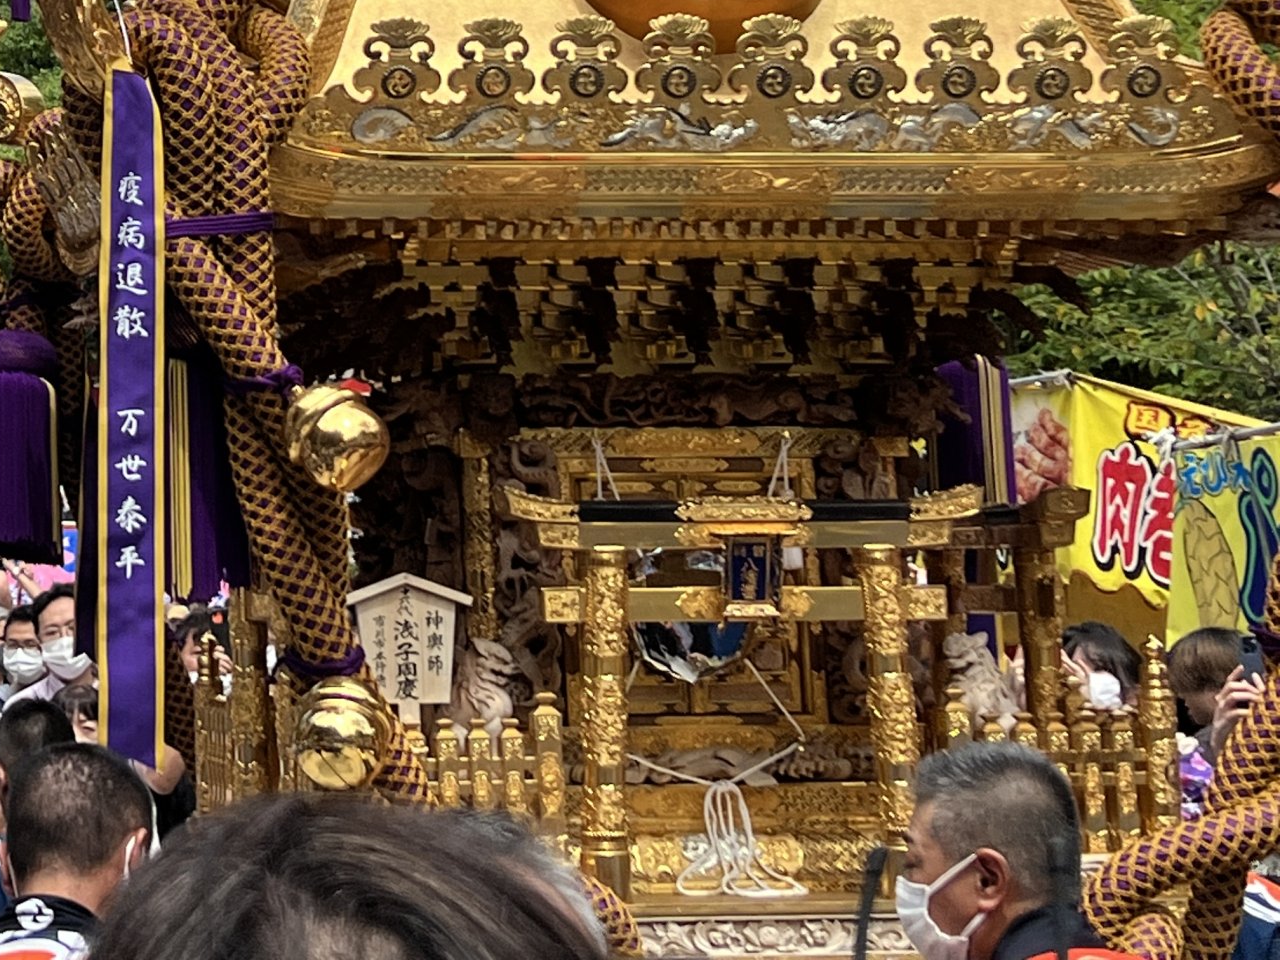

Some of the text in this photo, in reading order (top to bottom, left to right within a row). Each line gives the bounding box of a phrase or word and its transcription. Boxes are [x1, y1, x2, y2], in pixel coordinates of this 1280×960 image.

[112, 171, 149, 580] 疫病退散 万世泰平
